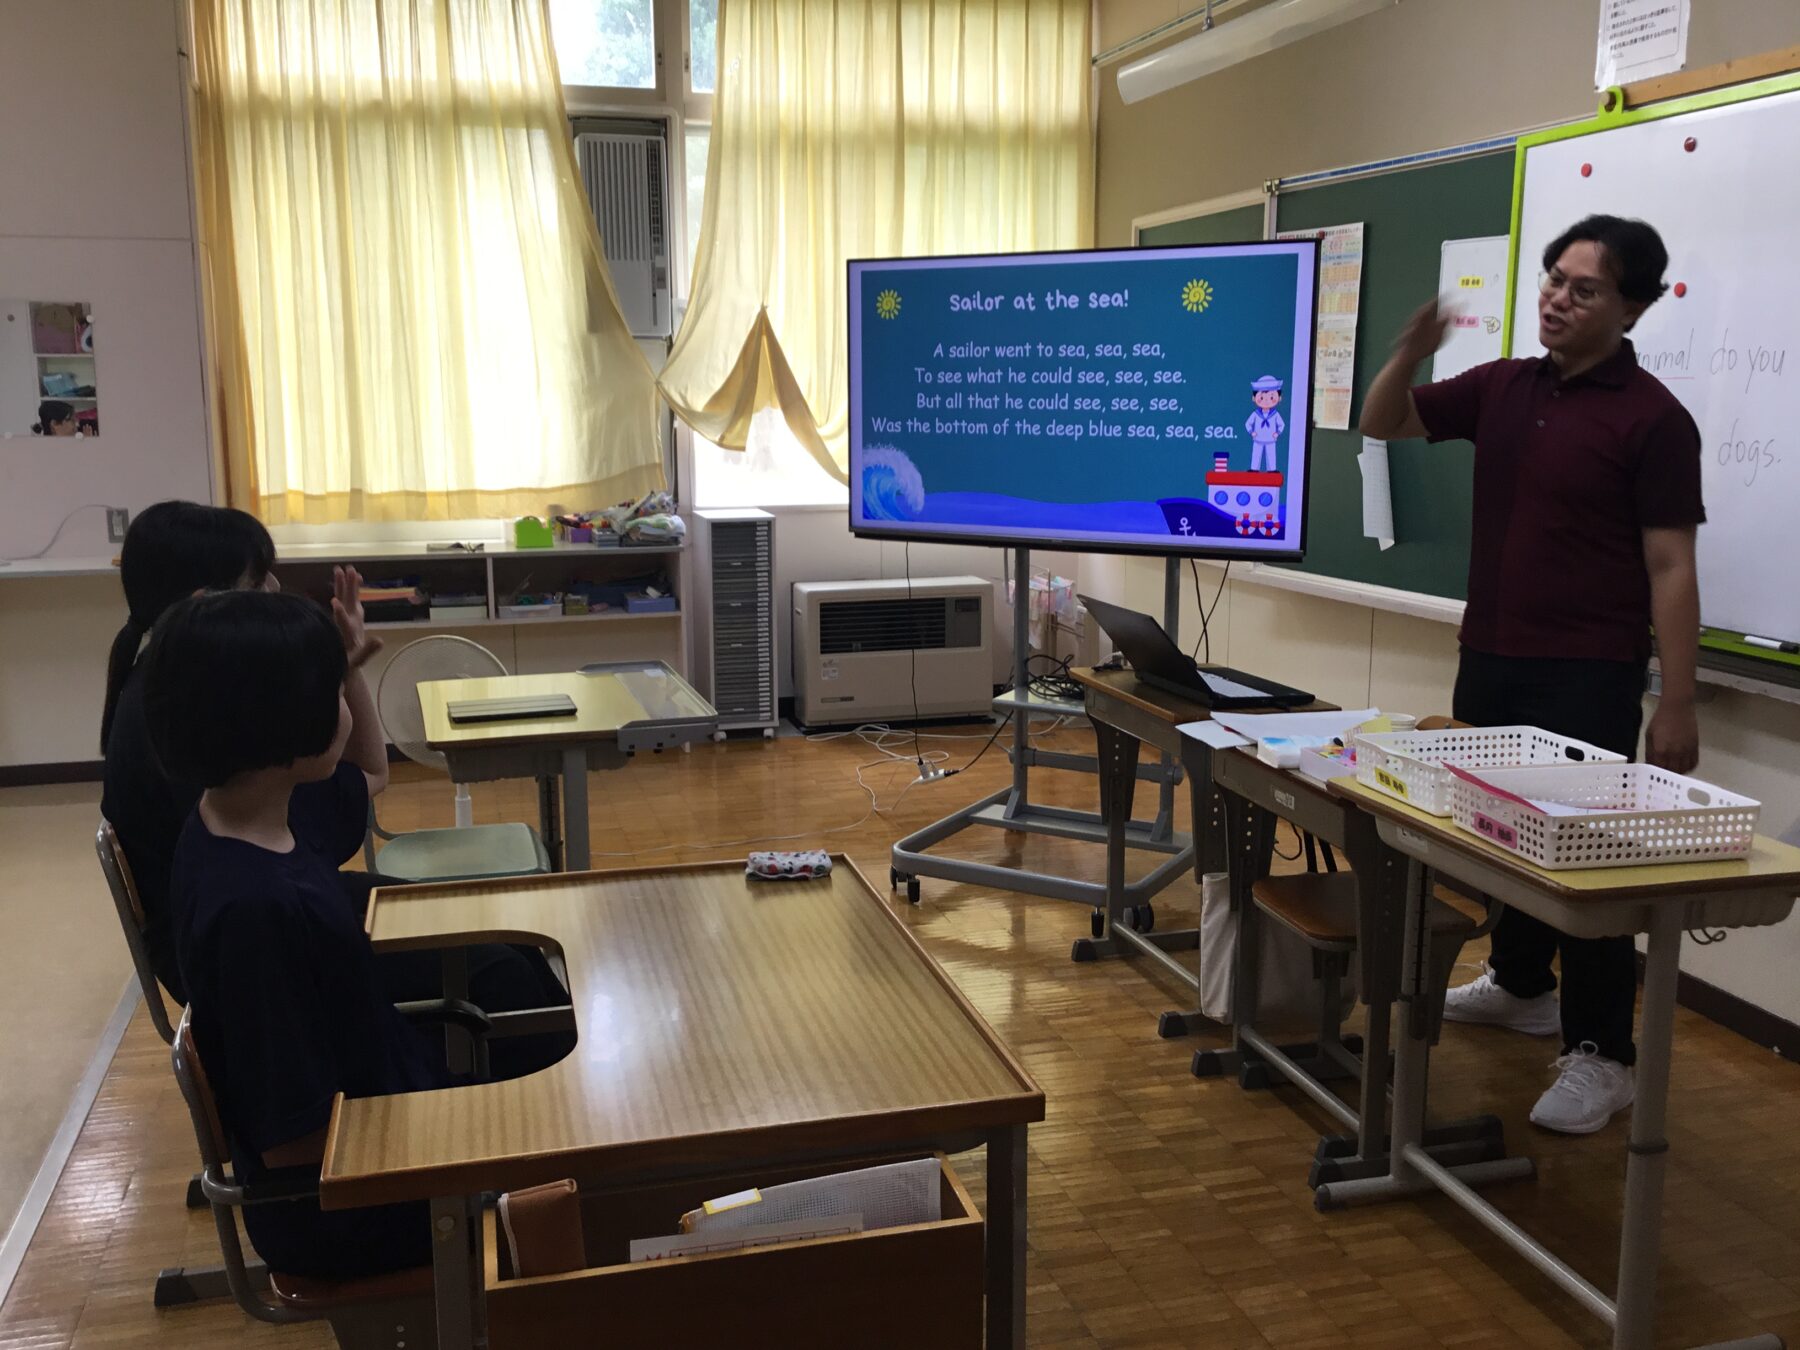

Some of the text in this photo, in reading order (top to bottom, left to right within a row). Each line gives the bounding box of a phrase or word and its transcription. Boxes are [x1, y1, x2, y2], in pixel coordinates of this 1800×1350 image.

[950, 289, 1128, 312] Sailor at the sea!
[933, 341, 1166, 360] A sailor went to sea, sea, sea,
[1637, 328, 1786, 394] nimal do you
[914, 367, 1187, 387] To see what he could see, see, see.
[917, 392, 1184, 414] But all that he could see, see, see,
[871, 417, 1239, 441] Was the bottom of the deep blue sea, sea, sea.
[1717, 418, 1782, 488] dogs.
